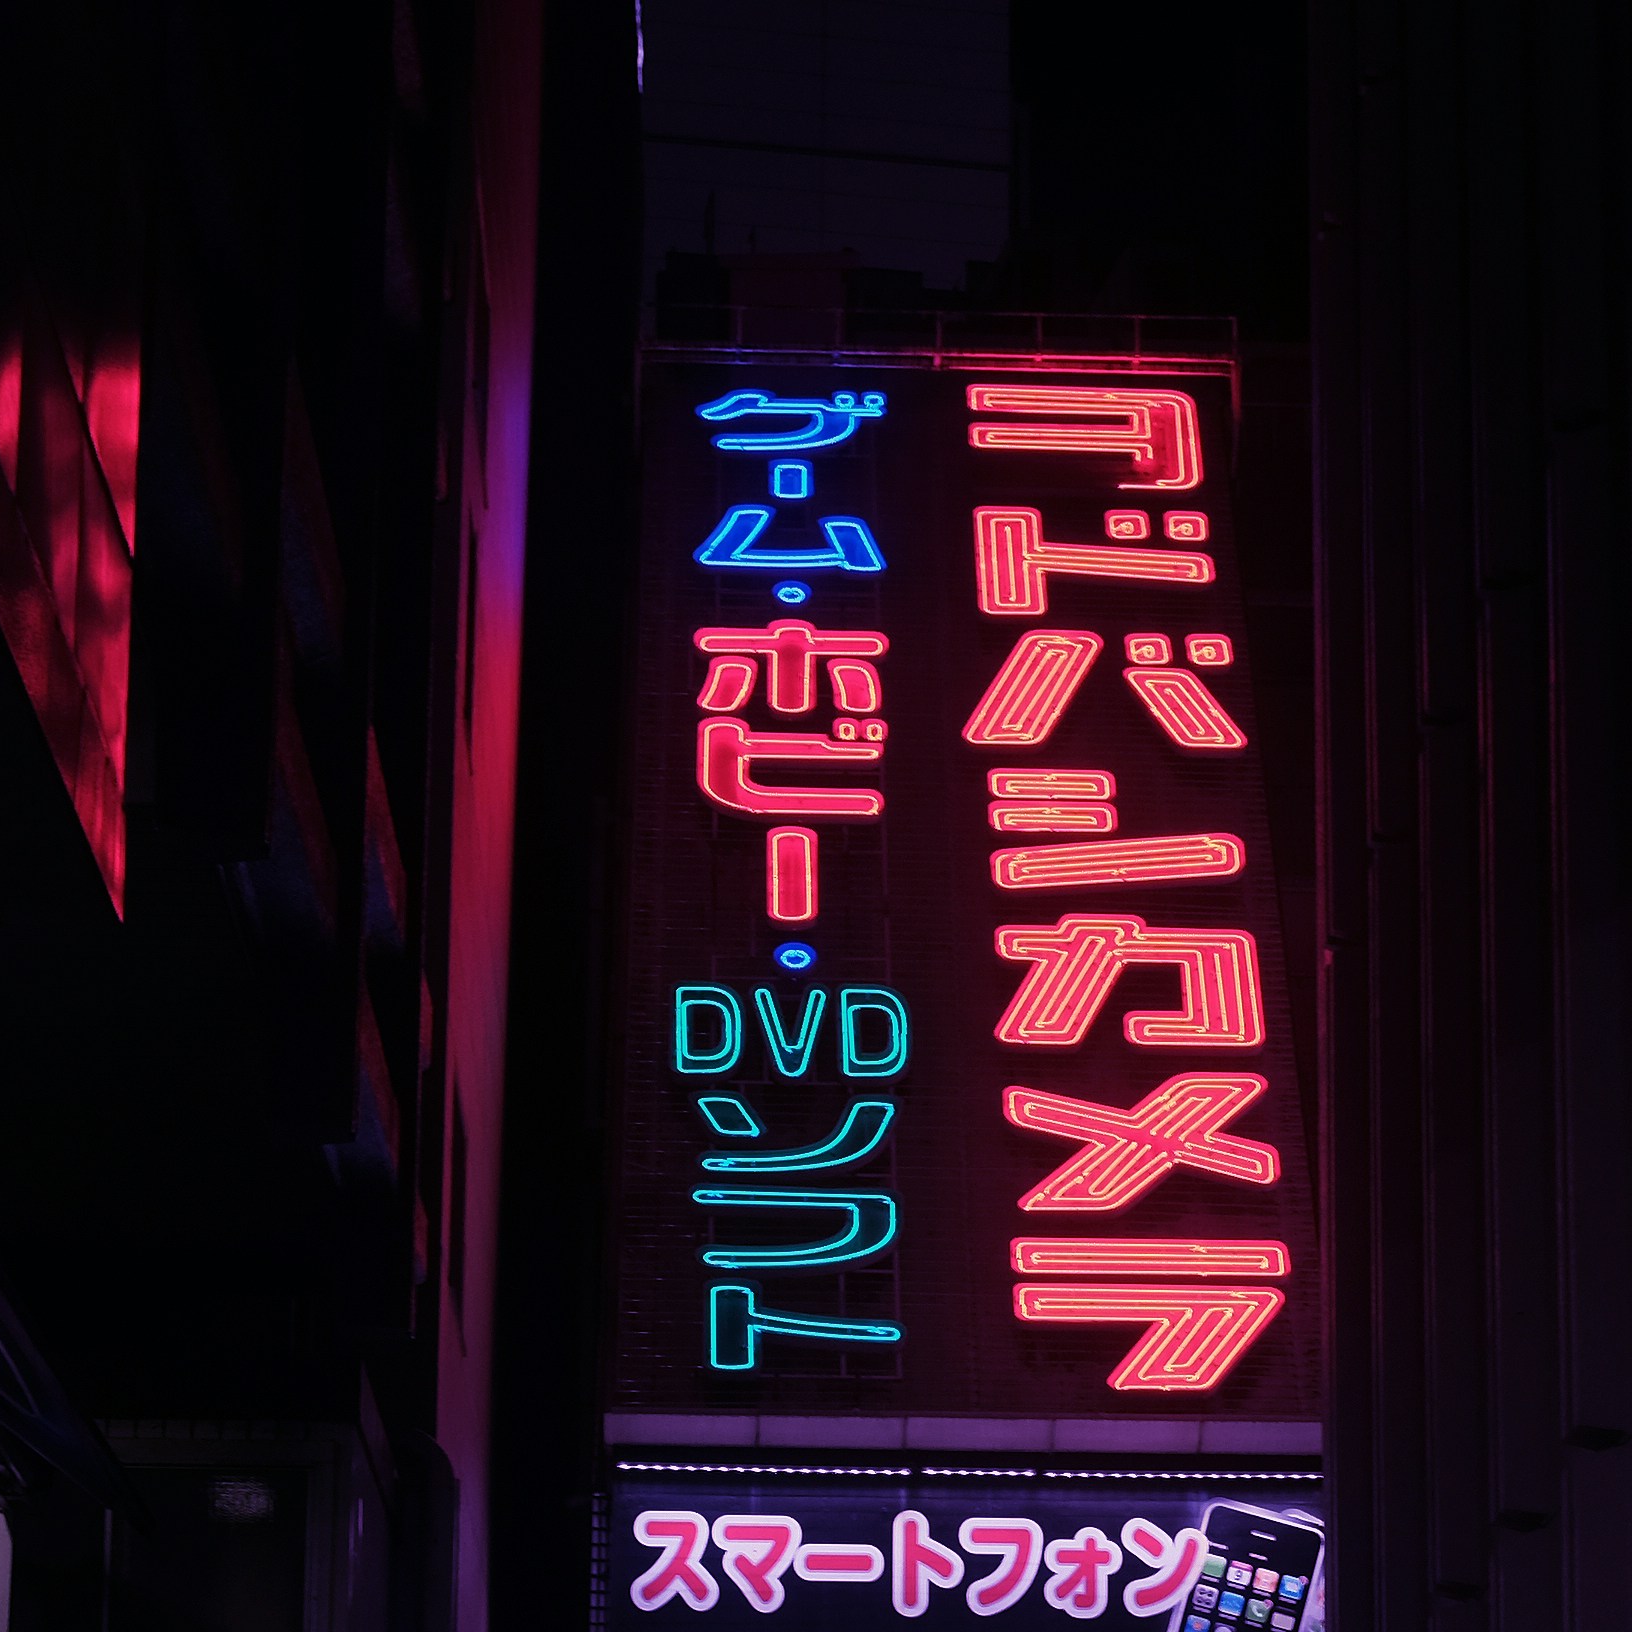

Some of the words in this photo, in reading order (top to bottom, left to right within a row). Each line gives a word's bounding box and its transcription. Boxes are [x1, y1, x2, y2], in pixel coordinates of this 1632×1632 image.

[962, 383, 1291, 1393] ヨドバシカメラ
[631, 1509, 1208, 1618] スマートフォン
